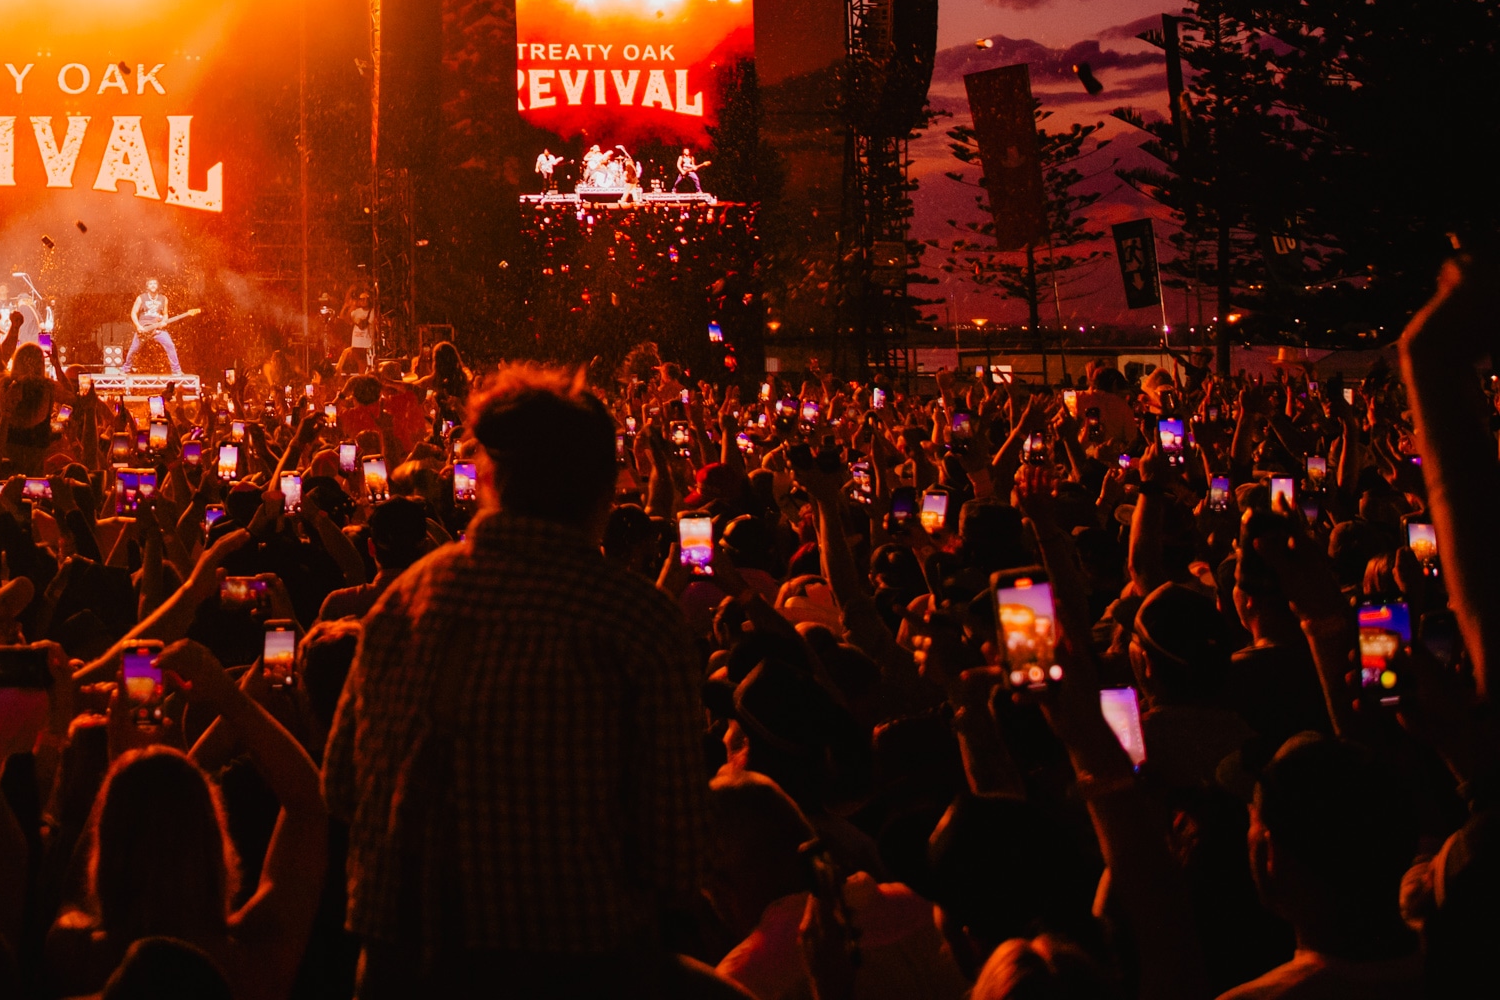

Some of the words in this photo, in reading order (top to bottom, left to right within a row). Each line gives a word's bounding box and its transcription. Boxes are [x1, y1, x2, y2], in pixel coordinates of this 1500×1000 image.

[516, 43, 613, 61] TREATY
[623, 44, 675, 61] OAK
[57, 62, 167, 95] OAK
